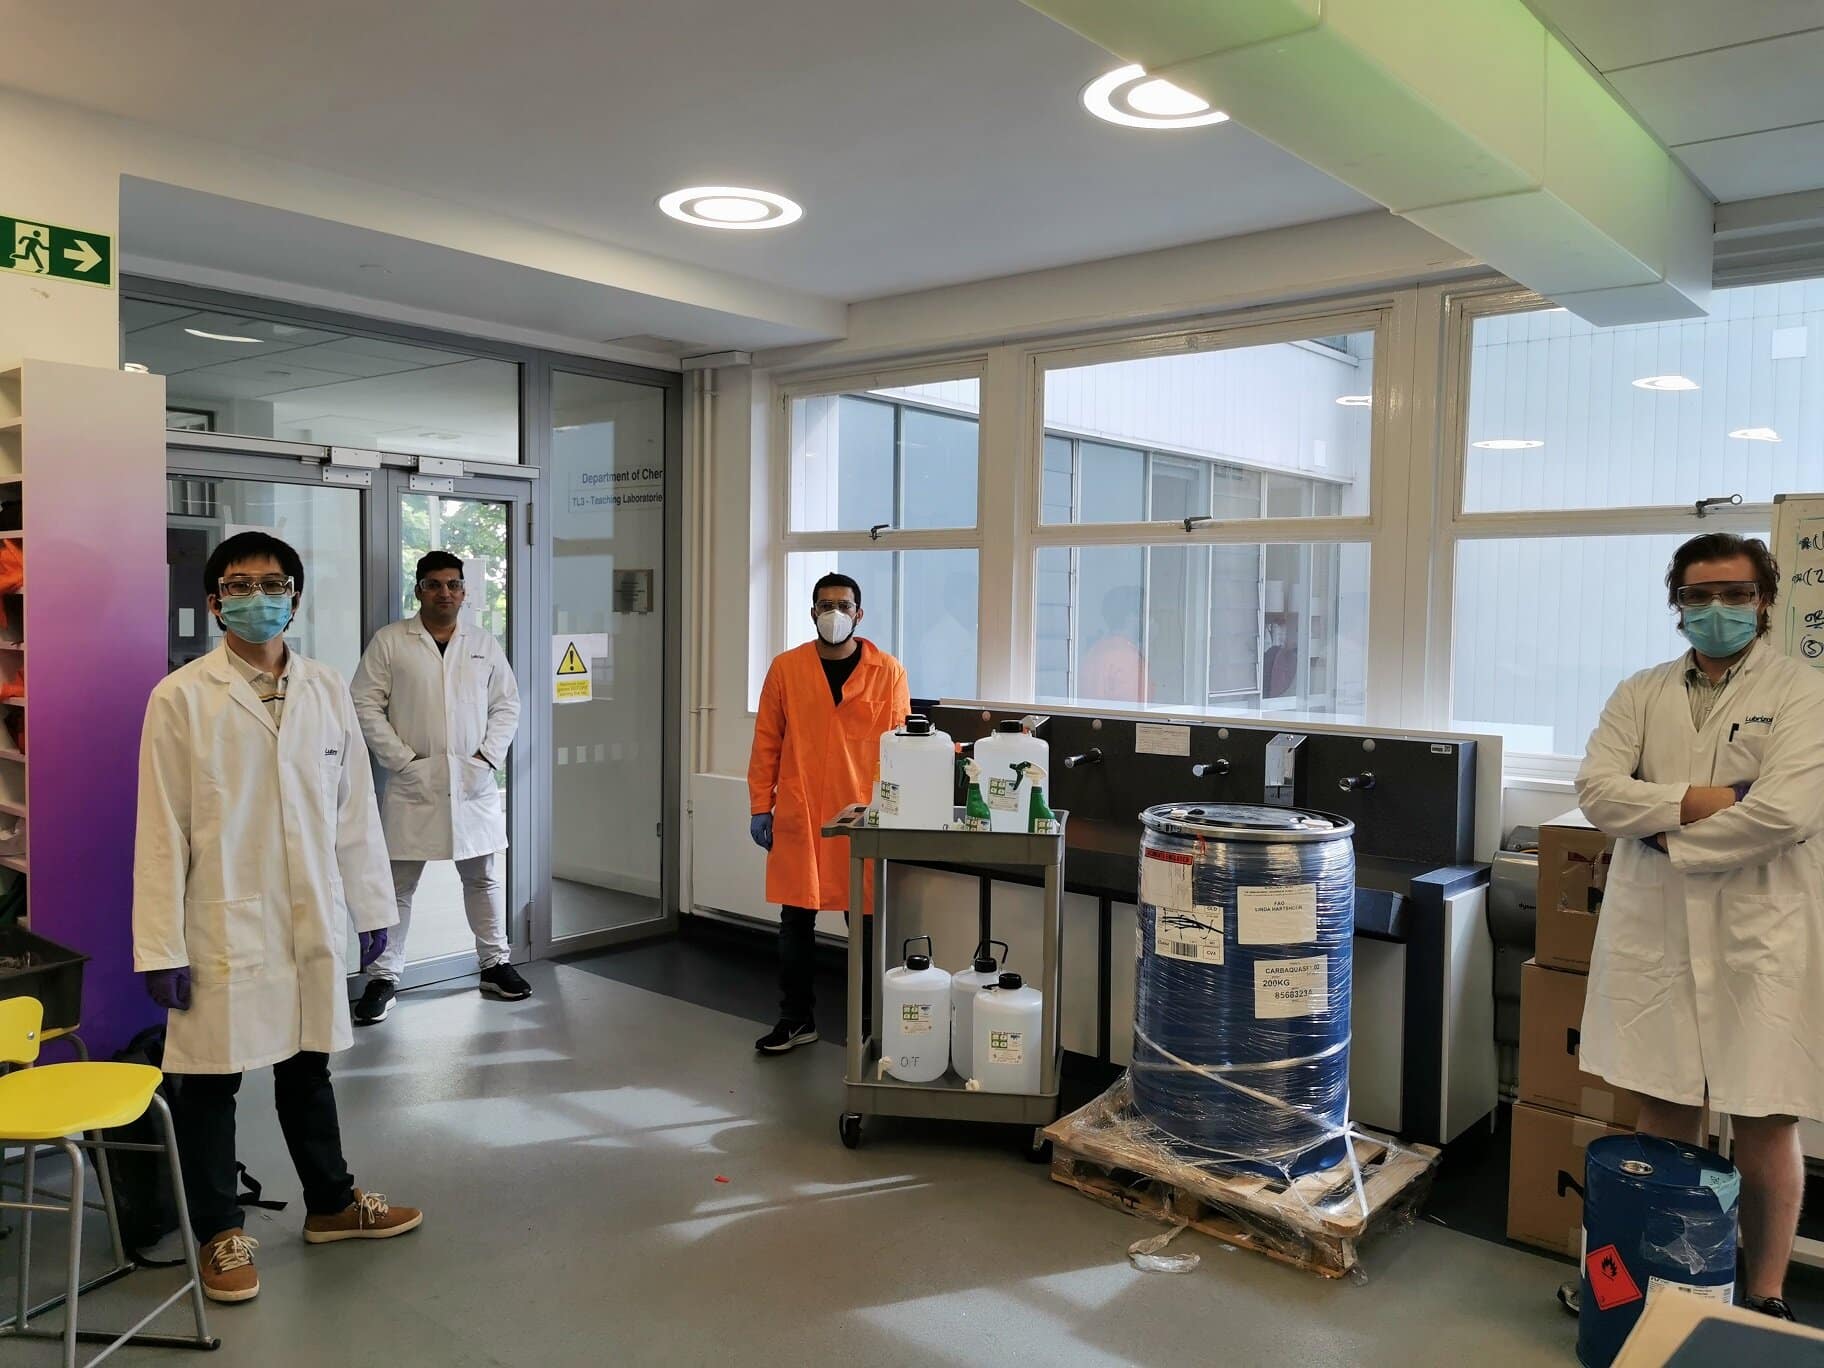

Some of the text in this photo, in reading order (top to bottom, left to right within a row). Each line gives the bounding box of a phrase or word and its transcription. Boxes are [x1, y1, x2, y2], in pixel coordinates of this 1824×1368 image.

[582, 470, 629, 485] Department
[631, 468, 640, 480] of
[590, 494, 621, 506] Teaching
[1263, 979, 1290, 987] 200KG
